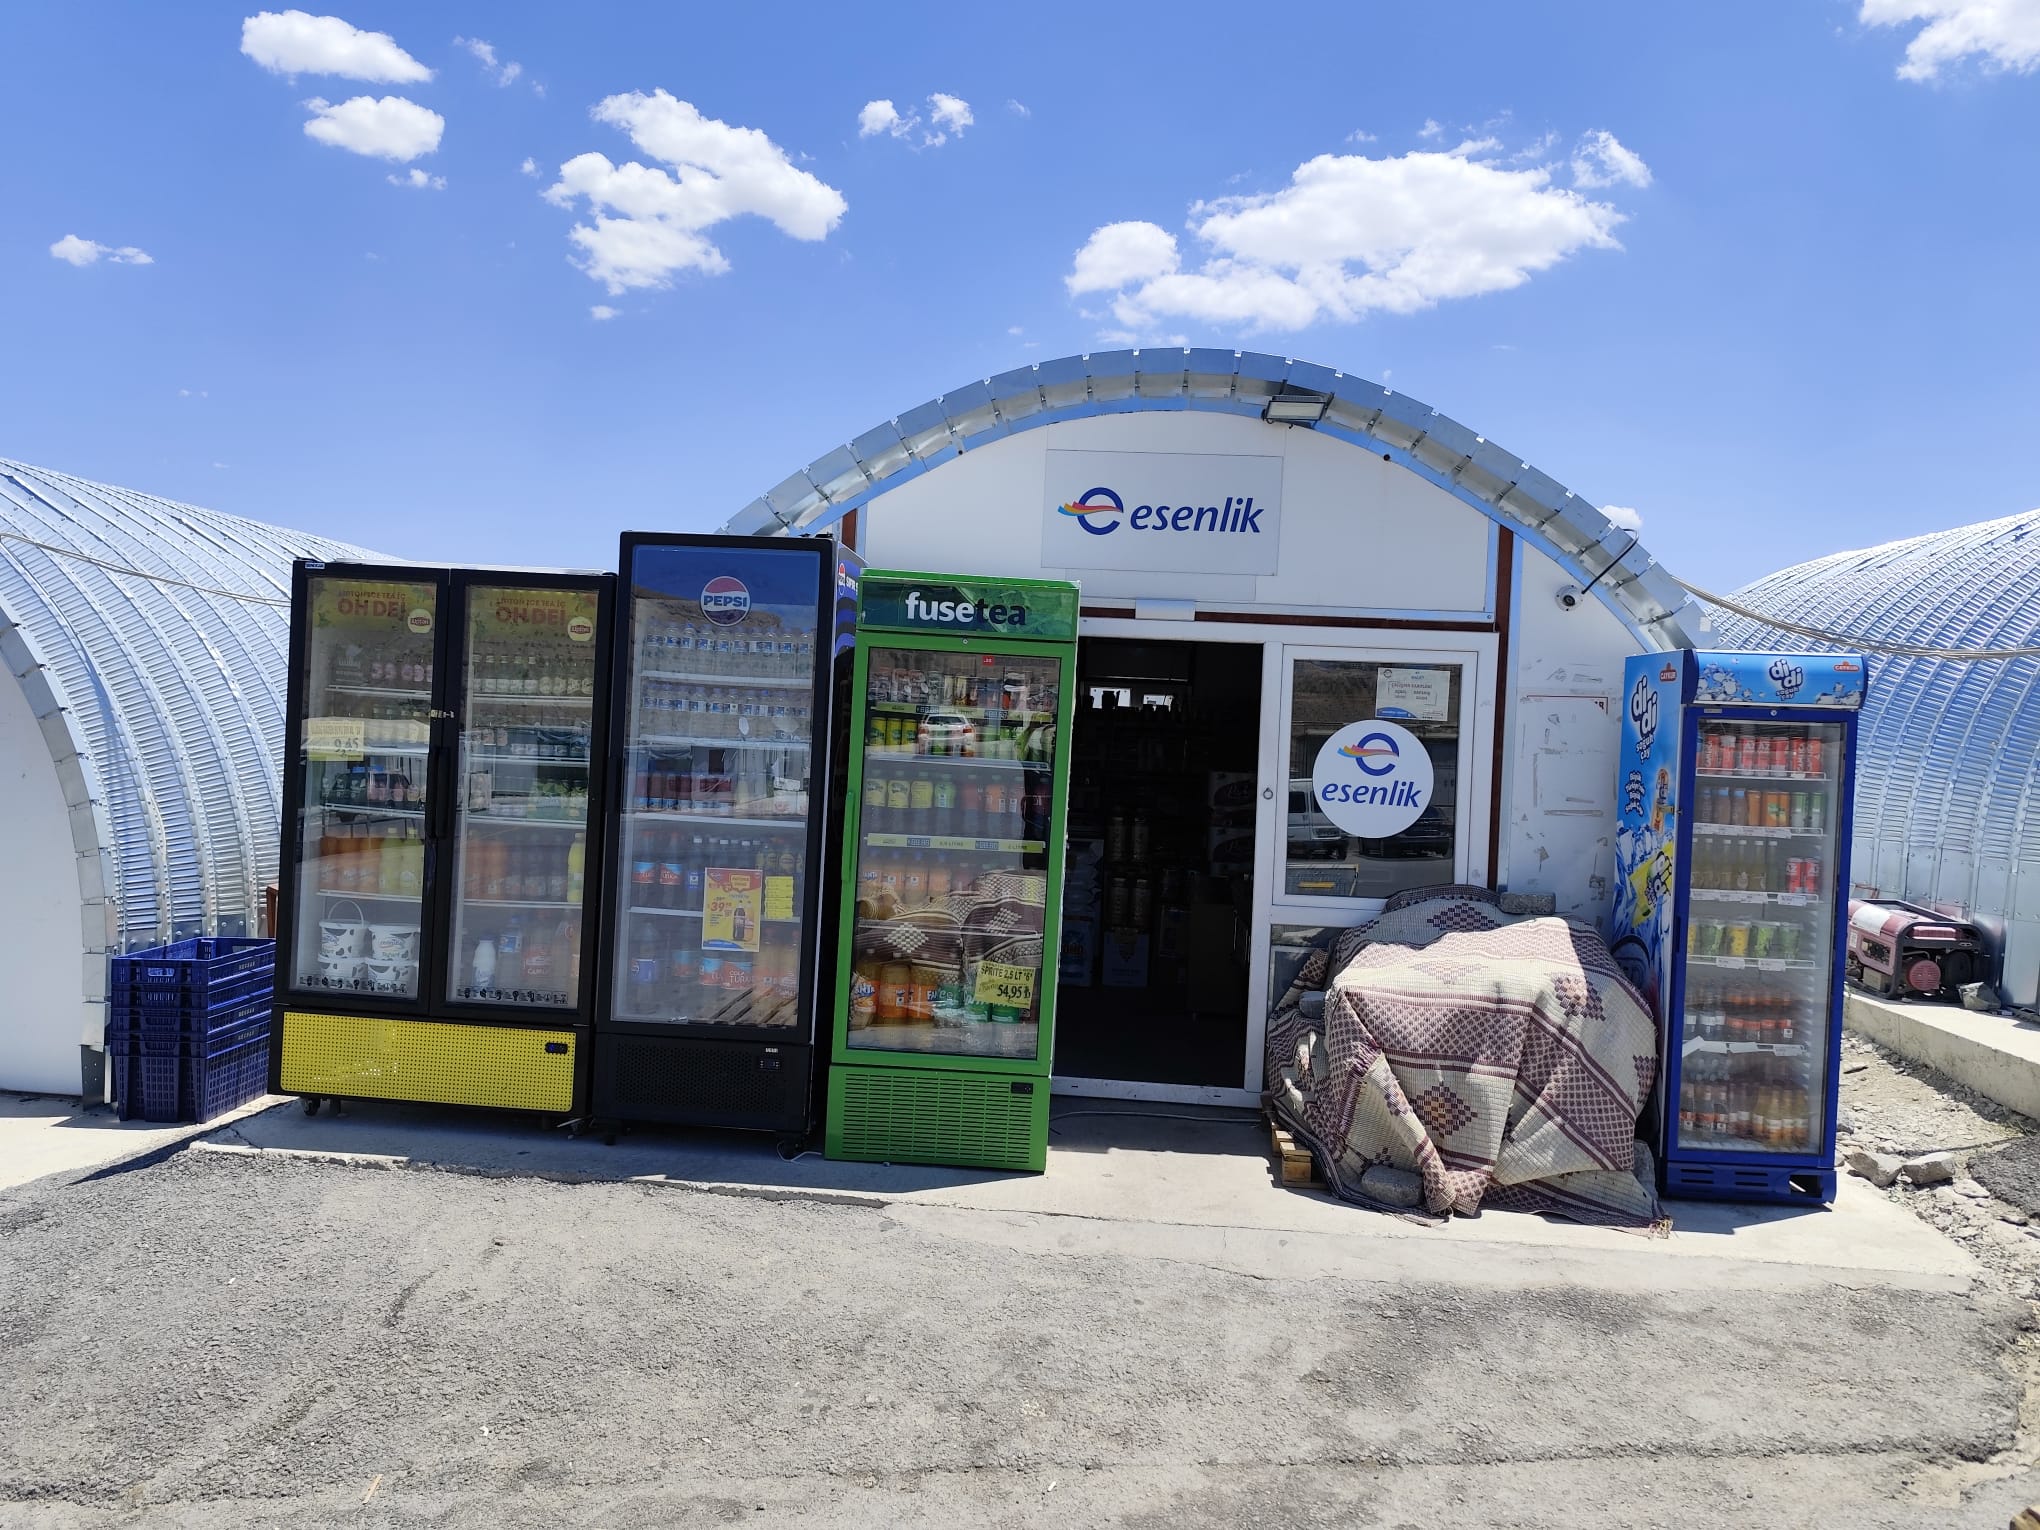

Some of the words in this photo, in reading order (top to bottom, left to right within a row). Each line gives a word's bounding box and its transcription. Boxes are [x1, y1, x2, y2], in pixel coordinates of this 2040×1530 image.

[1130, 497, 1264, 533] esenlik
[703, 595, 748, 608] PEPSI
[1321, 780, 1422, 808] esenlik
[981, 965, 1004, 978] SPRITE
[1004, 969, 1014, 980] 2,5
[1015, 971, 1023, 981] LT
[996, 984, 1022, 999] 54,95
